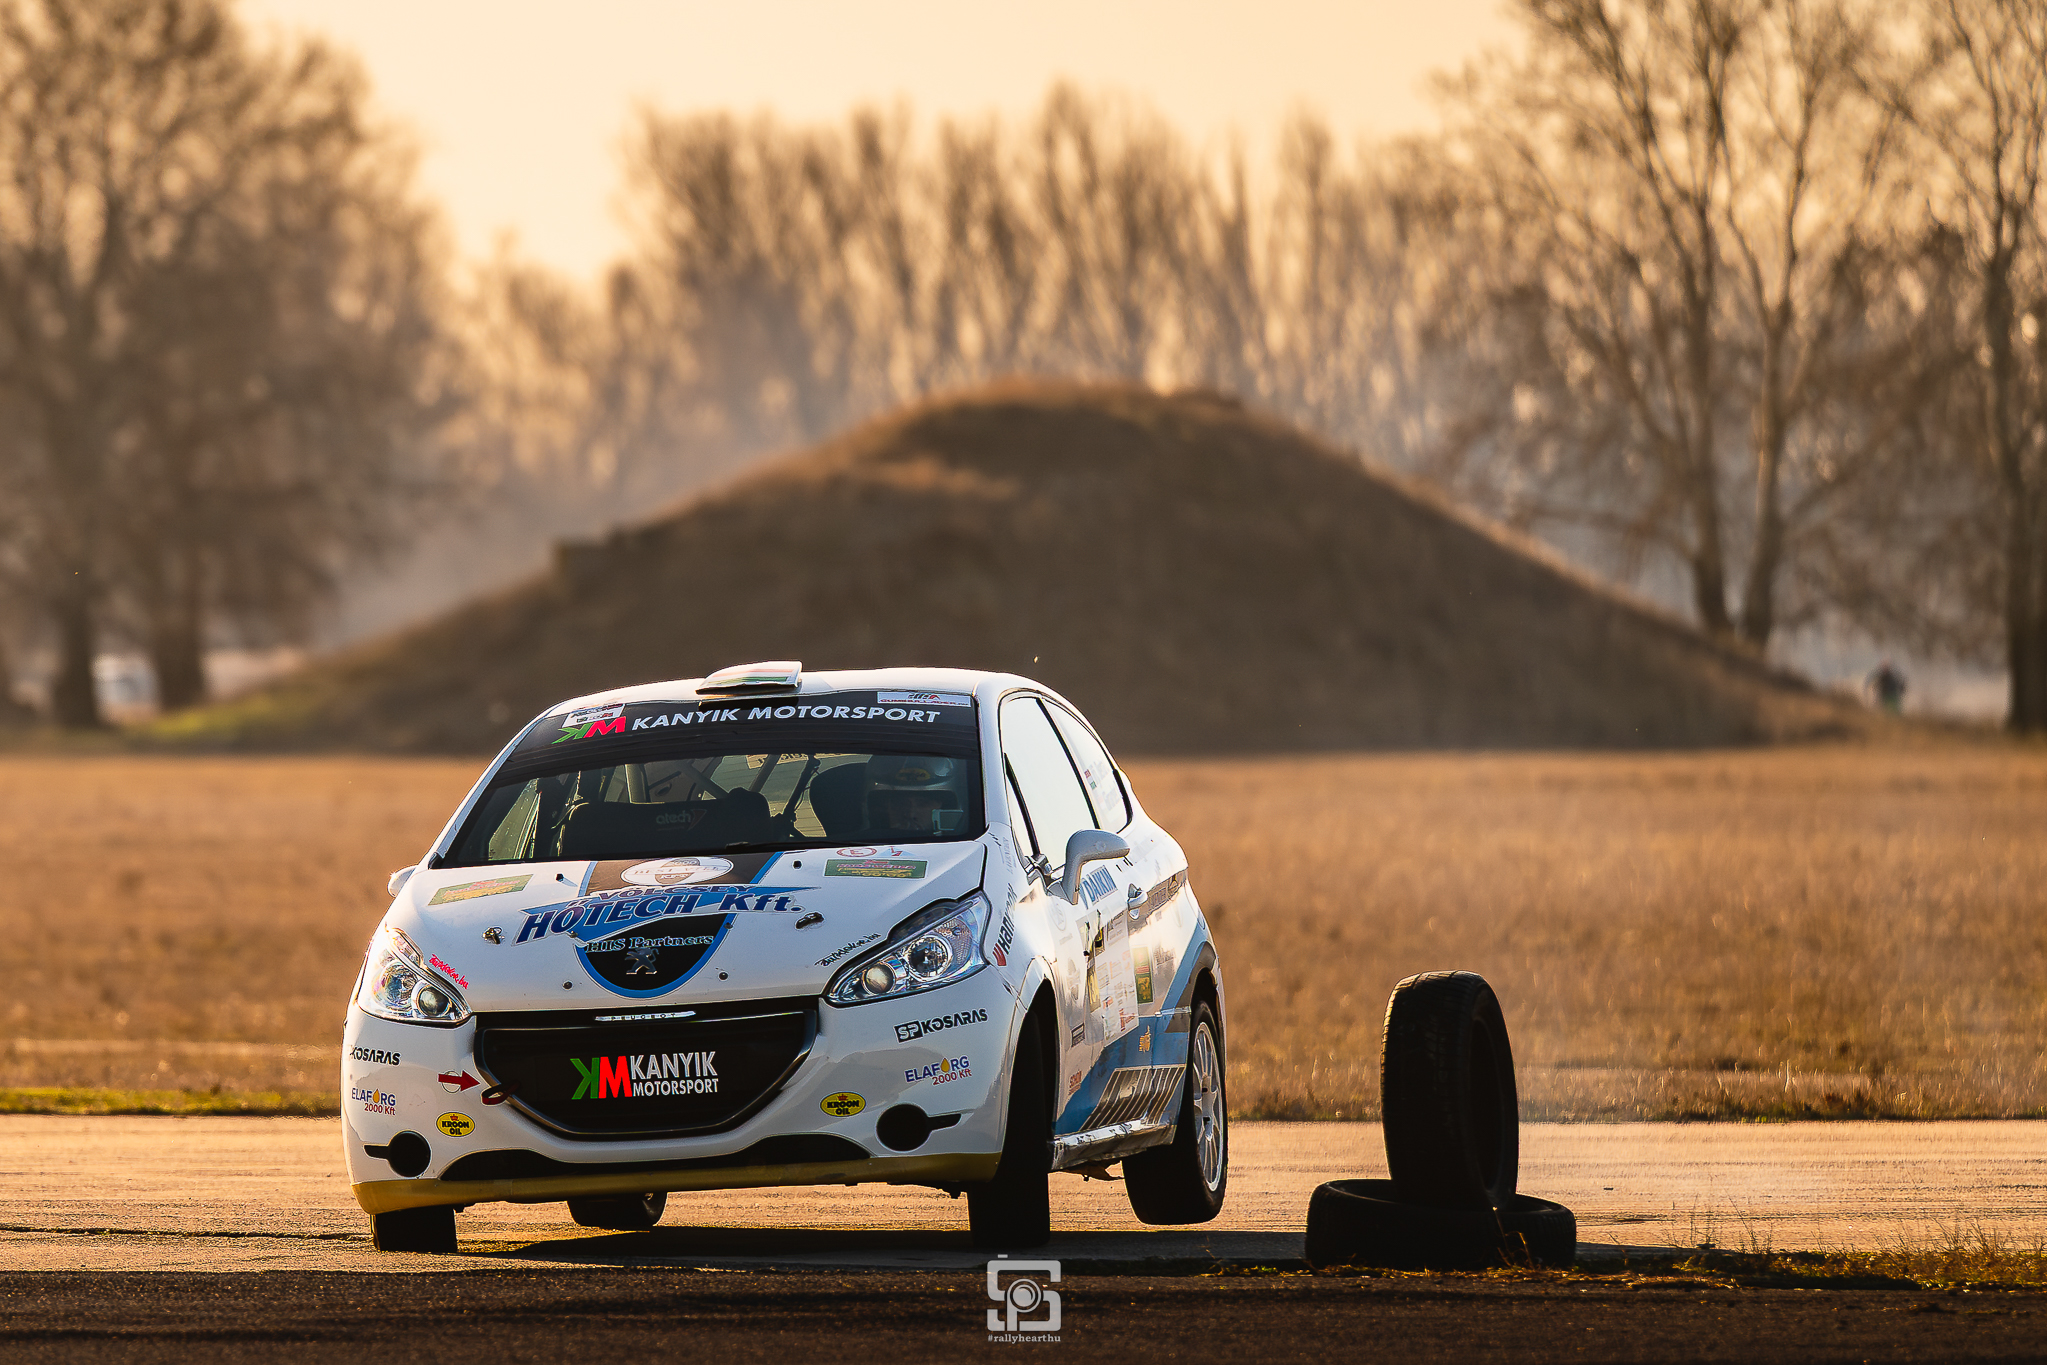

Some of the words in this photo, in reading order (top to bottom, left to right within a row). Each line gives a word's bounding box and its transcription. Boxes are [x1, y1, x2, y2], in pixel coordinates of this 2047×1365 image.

[632, 708, 740, 731] KANYIK
[747, 705, 941, 723] MOTORSPORT
[515, 894, 701, 944] HŐTECH
[718, 892, 805, 913] Kft.
[628, 936, 714, 949] Partners
[921, 1009, 988, 1034] KOSARAS
[630, 1051, 718, 1080] KANYIK
[932, 1072, 957, 1086] 2000
[633, 1078, 719, 1097] MOTORSPORT
[364, 1103, 383, 1114] 2000
[384, 1106, 396, 1116] Kft
[827, 1100, 860, 1109] KROON
[441, 1120, 470, 1129] KROON
[449, 1127, 462, 1135] OIL
